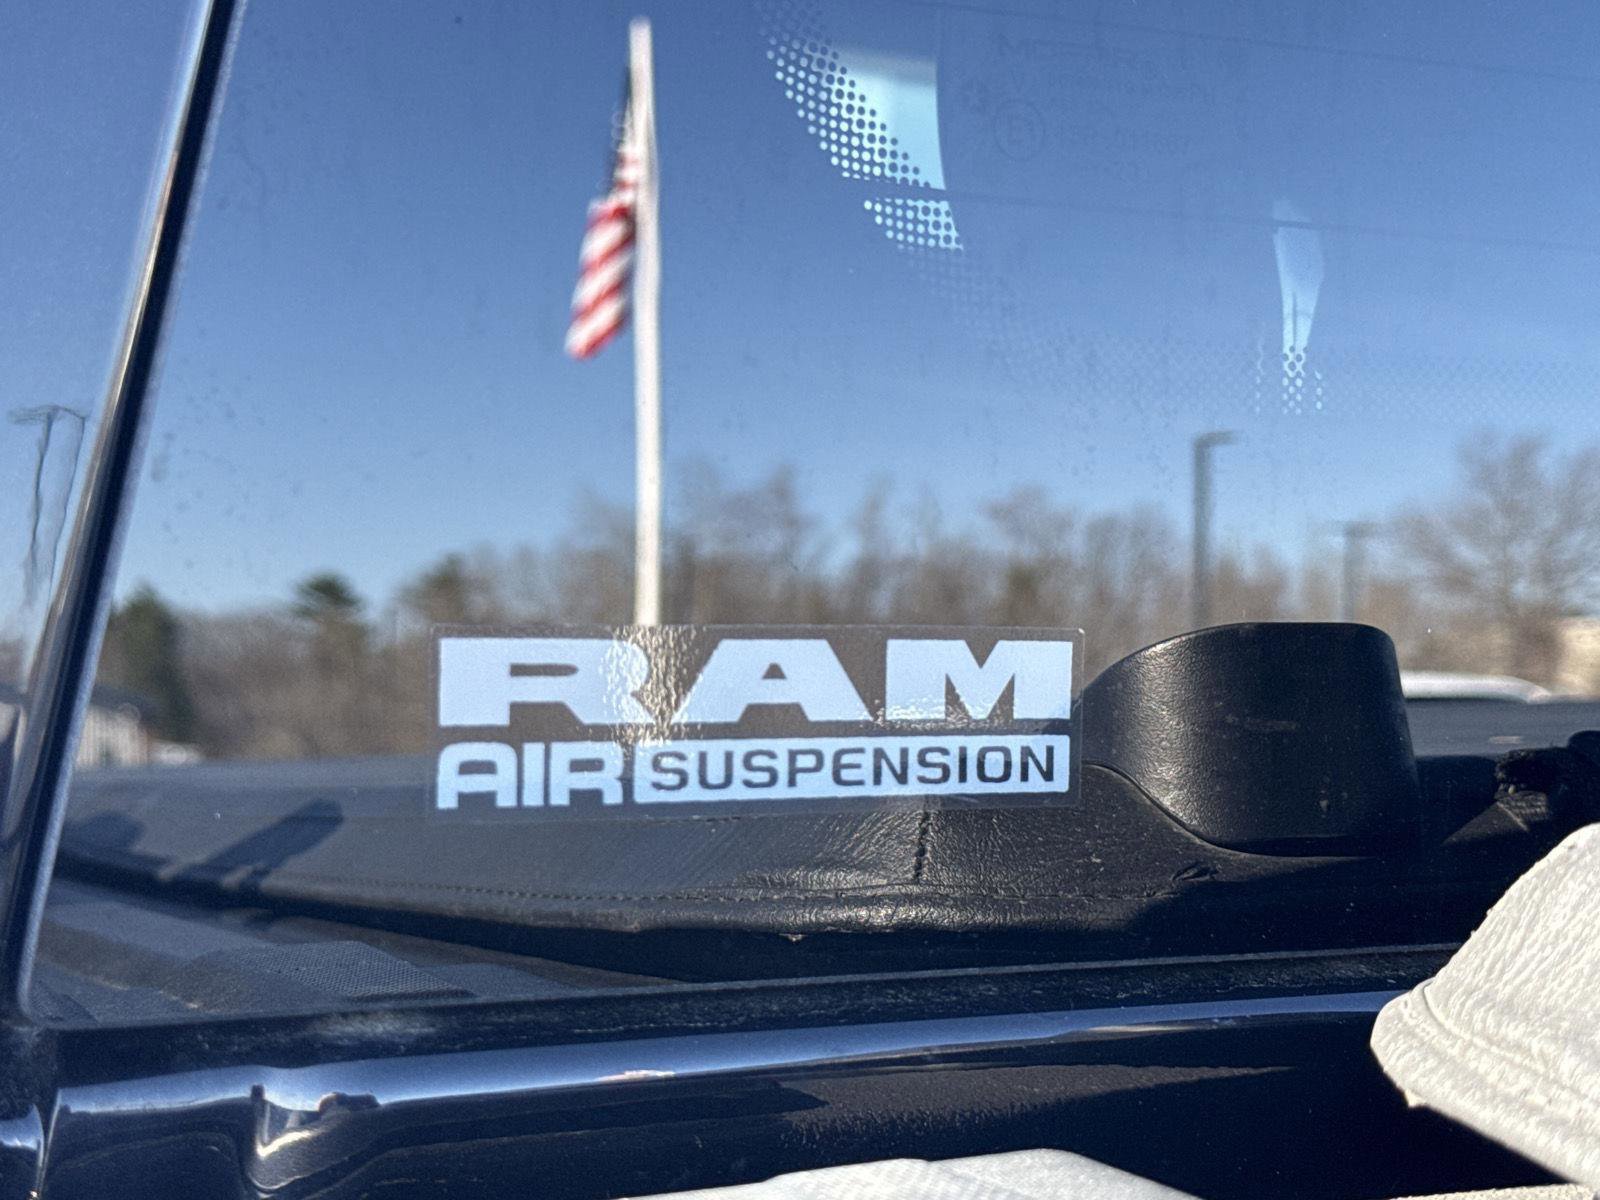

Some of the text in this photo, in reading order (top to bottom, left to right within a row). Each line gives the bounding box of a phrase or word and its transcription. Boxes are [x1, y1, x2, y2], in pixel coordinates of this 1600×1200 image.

[438, 638, 1074, 726] RAM
[437, 741, 1056, 809] AIR SUSPENSION
